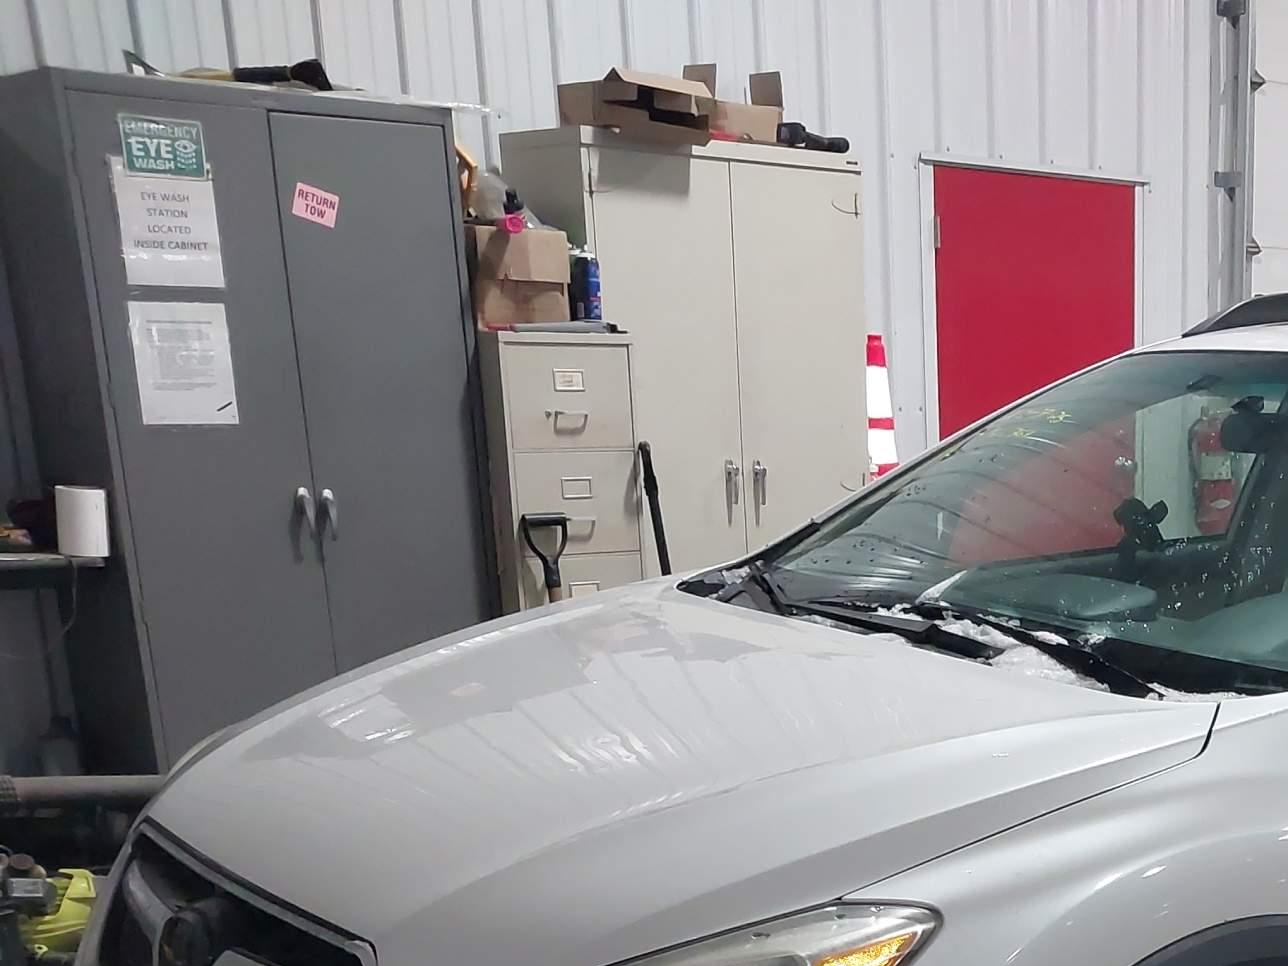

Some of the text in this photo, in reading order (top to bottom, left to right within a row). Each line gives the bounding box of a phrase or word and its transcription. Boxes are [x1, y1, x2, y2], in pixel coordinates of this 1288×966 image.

[128, 136, 174, 159] EYE
[133, 157, 175, 170] WASH
[140, 191, 190, 202] EYE WASH
[297, 188, 336, 211] RETURN
[146, 207, 188, 219] STATION
[304, 202, 326, 219] TOW
[147, 224, 192, 234] LOCATED
[133, 239, 209, 251] INSIDE CABINET
